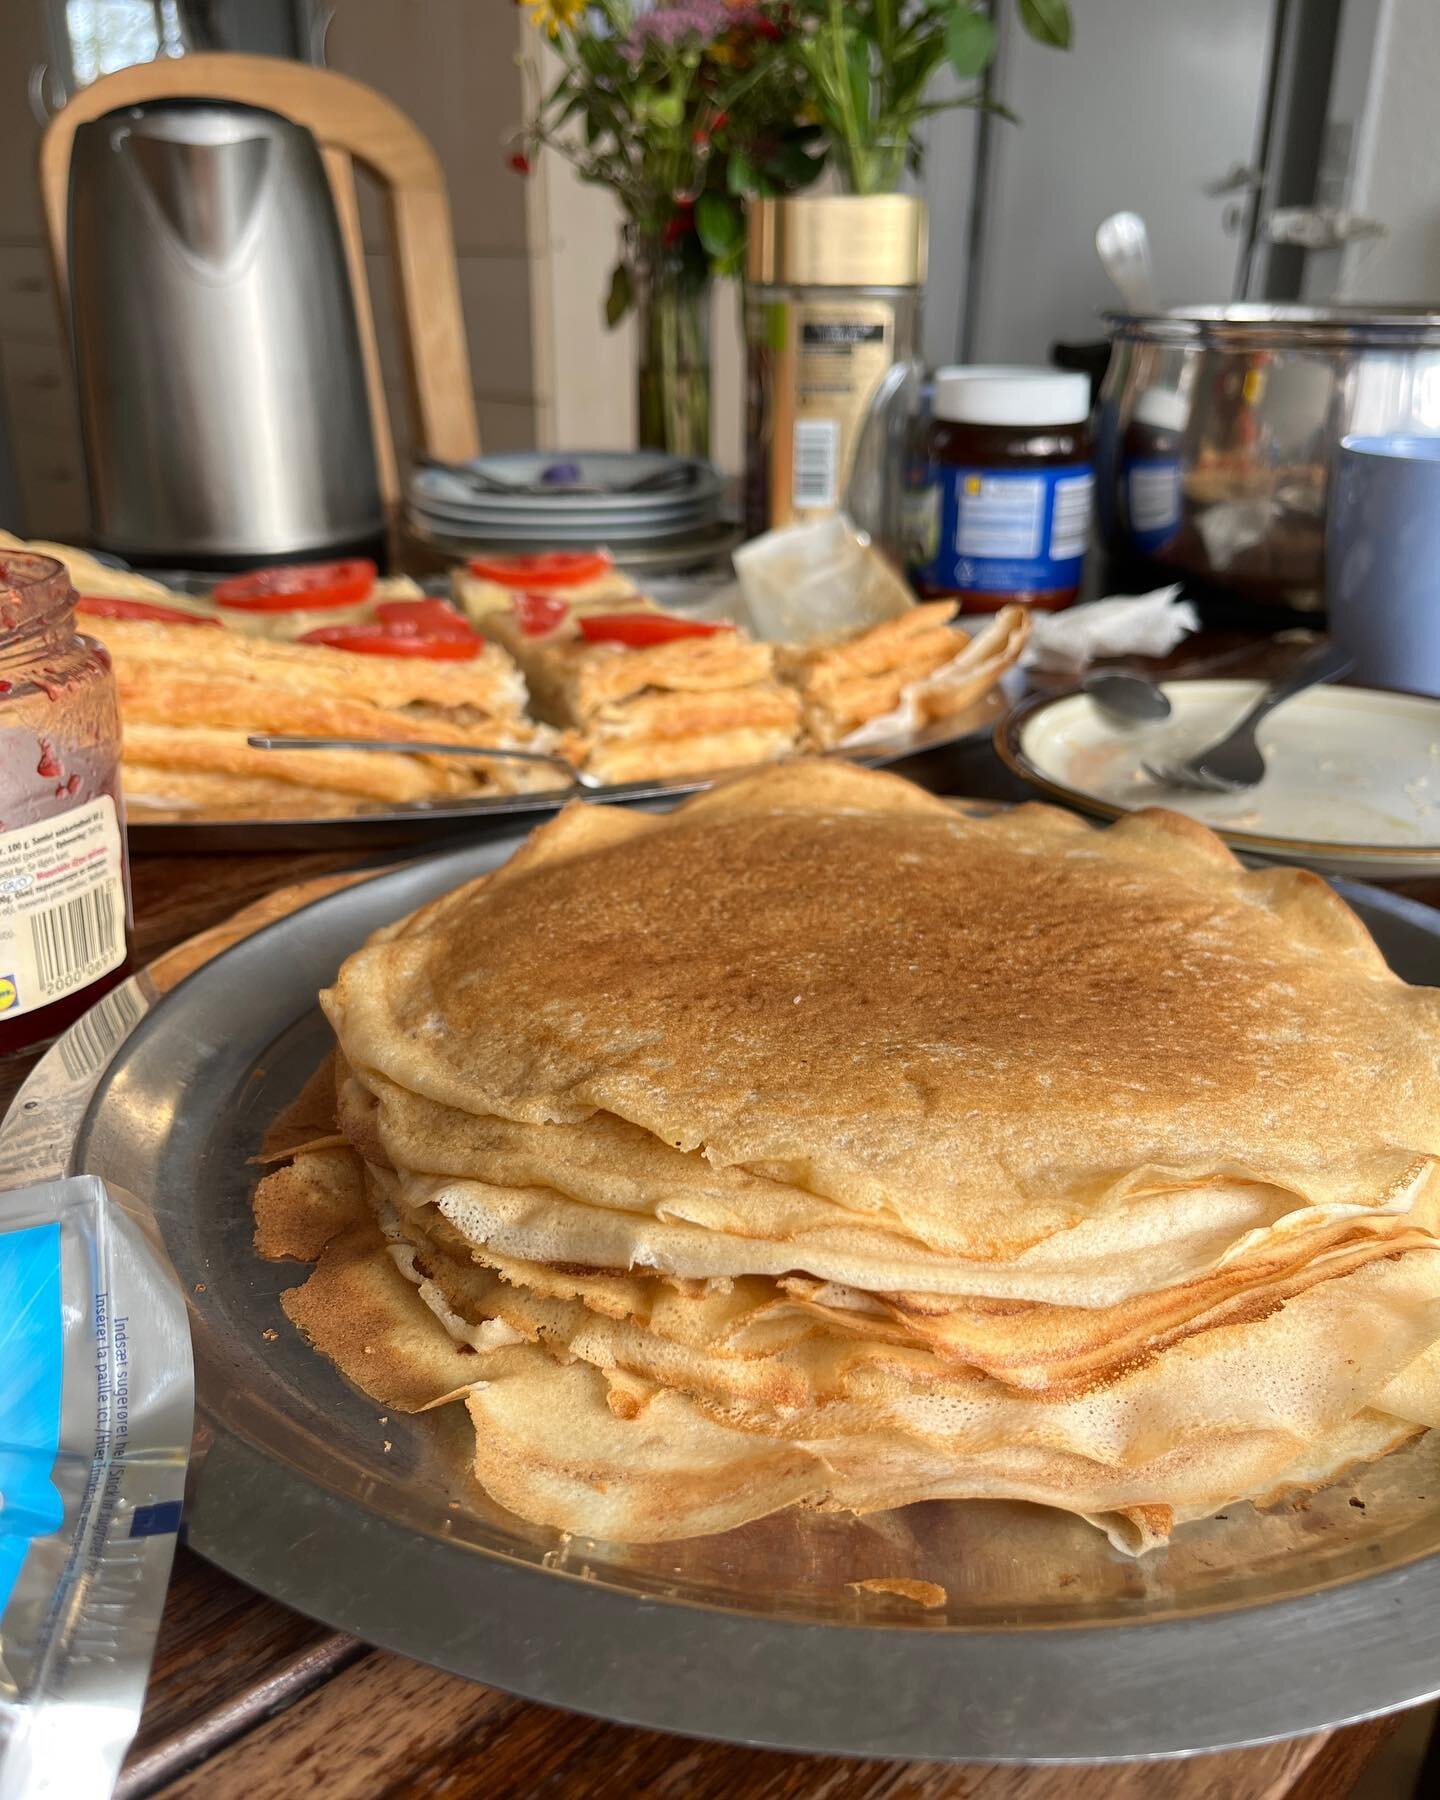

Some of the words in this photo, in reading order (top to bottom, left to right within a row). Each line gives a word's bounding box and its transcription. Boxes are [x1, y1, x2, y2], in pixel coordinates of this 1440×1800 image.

[47, 969, 81, 996] 2000
[95, 1292, 109, 1341] Insérer
[97, 1346, 110, 1359] la
[114, 1317, 129, 1367] Indsæt
[95, 1362, 112, 1402] paille
[113, 1371, 129, 1440] sugerøret
